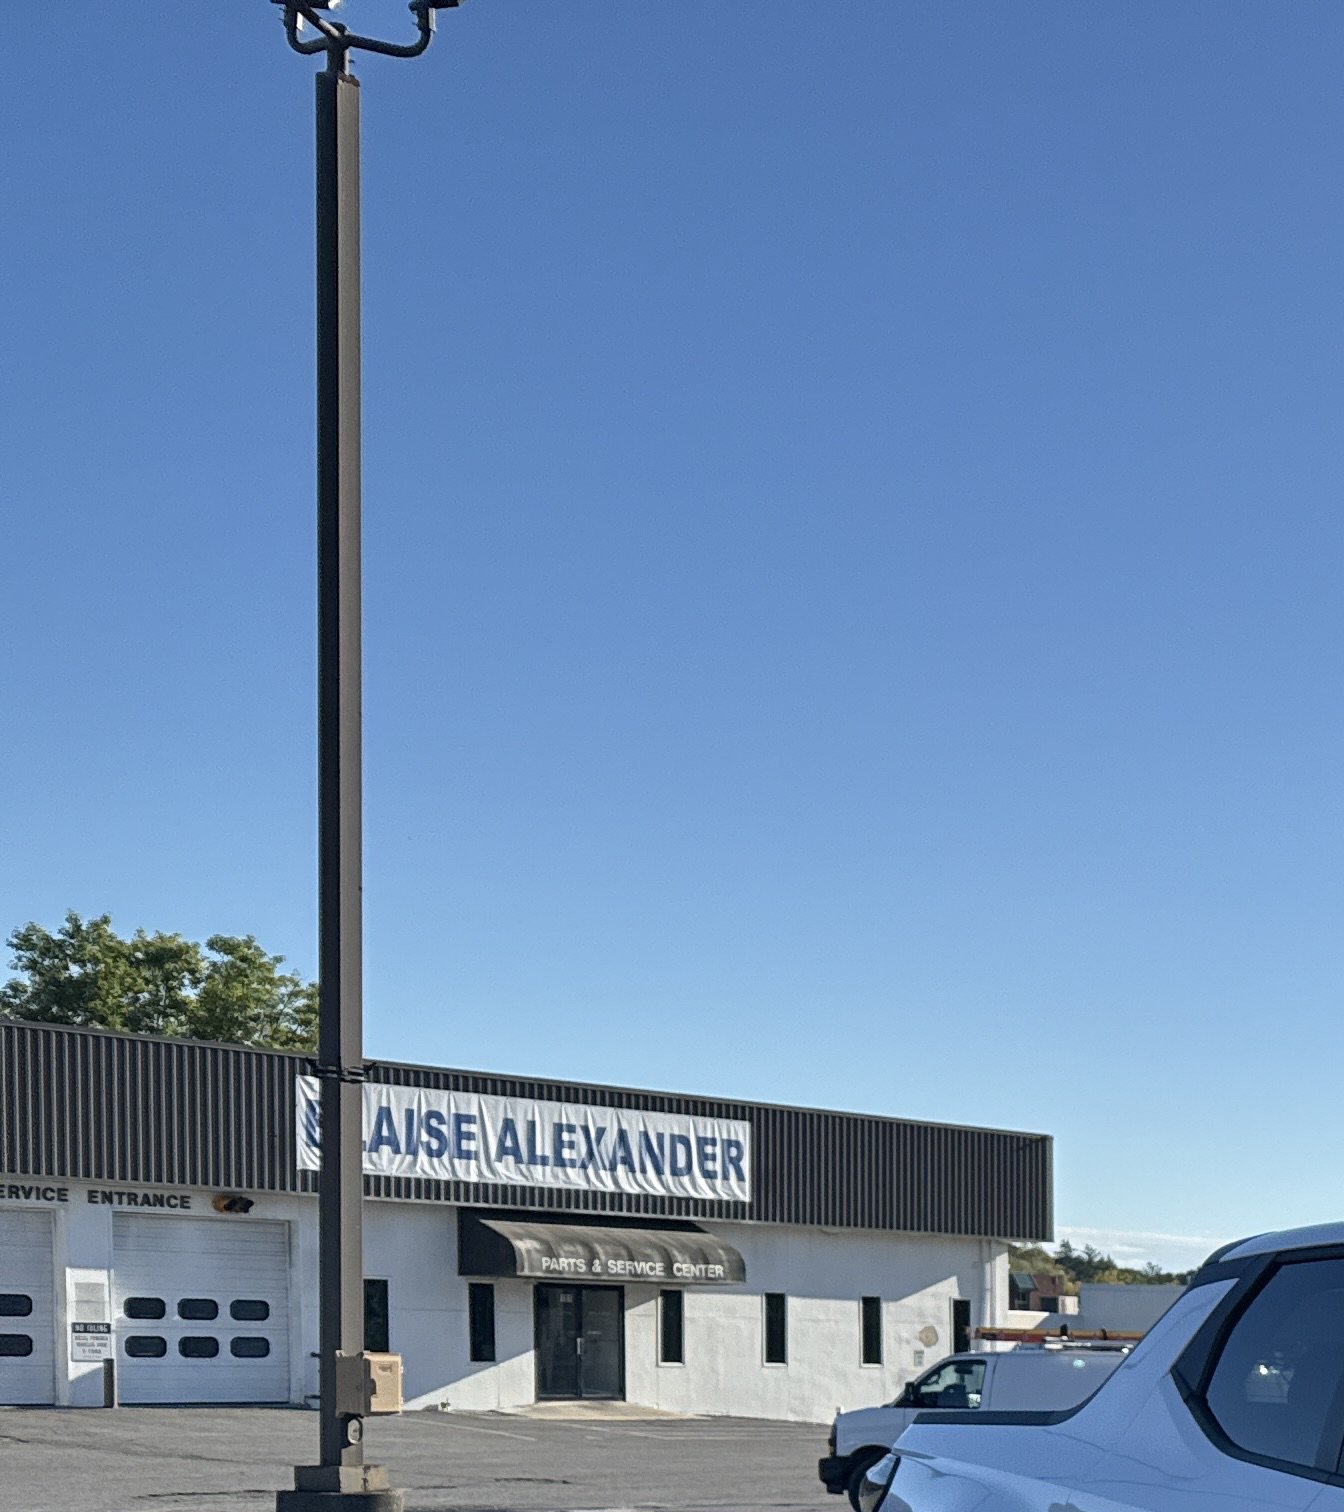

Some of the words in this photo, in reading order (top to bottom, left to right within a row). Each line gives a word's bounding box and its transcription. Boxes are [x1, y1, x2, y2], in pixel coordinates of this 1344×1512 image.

[304, 1098, 477, 1161] BAISE
[495, 1116, 746, 1182] ALEXANDER
[87, 1189, 192, 1209] ENTRANCE
[541, 1256, 586, 1273] PARTS
[592, 1259, 601, 1273] &
[607, 1259, 665, 1277] SERVICE
[672, 1262, 724, 1278] CENTER
